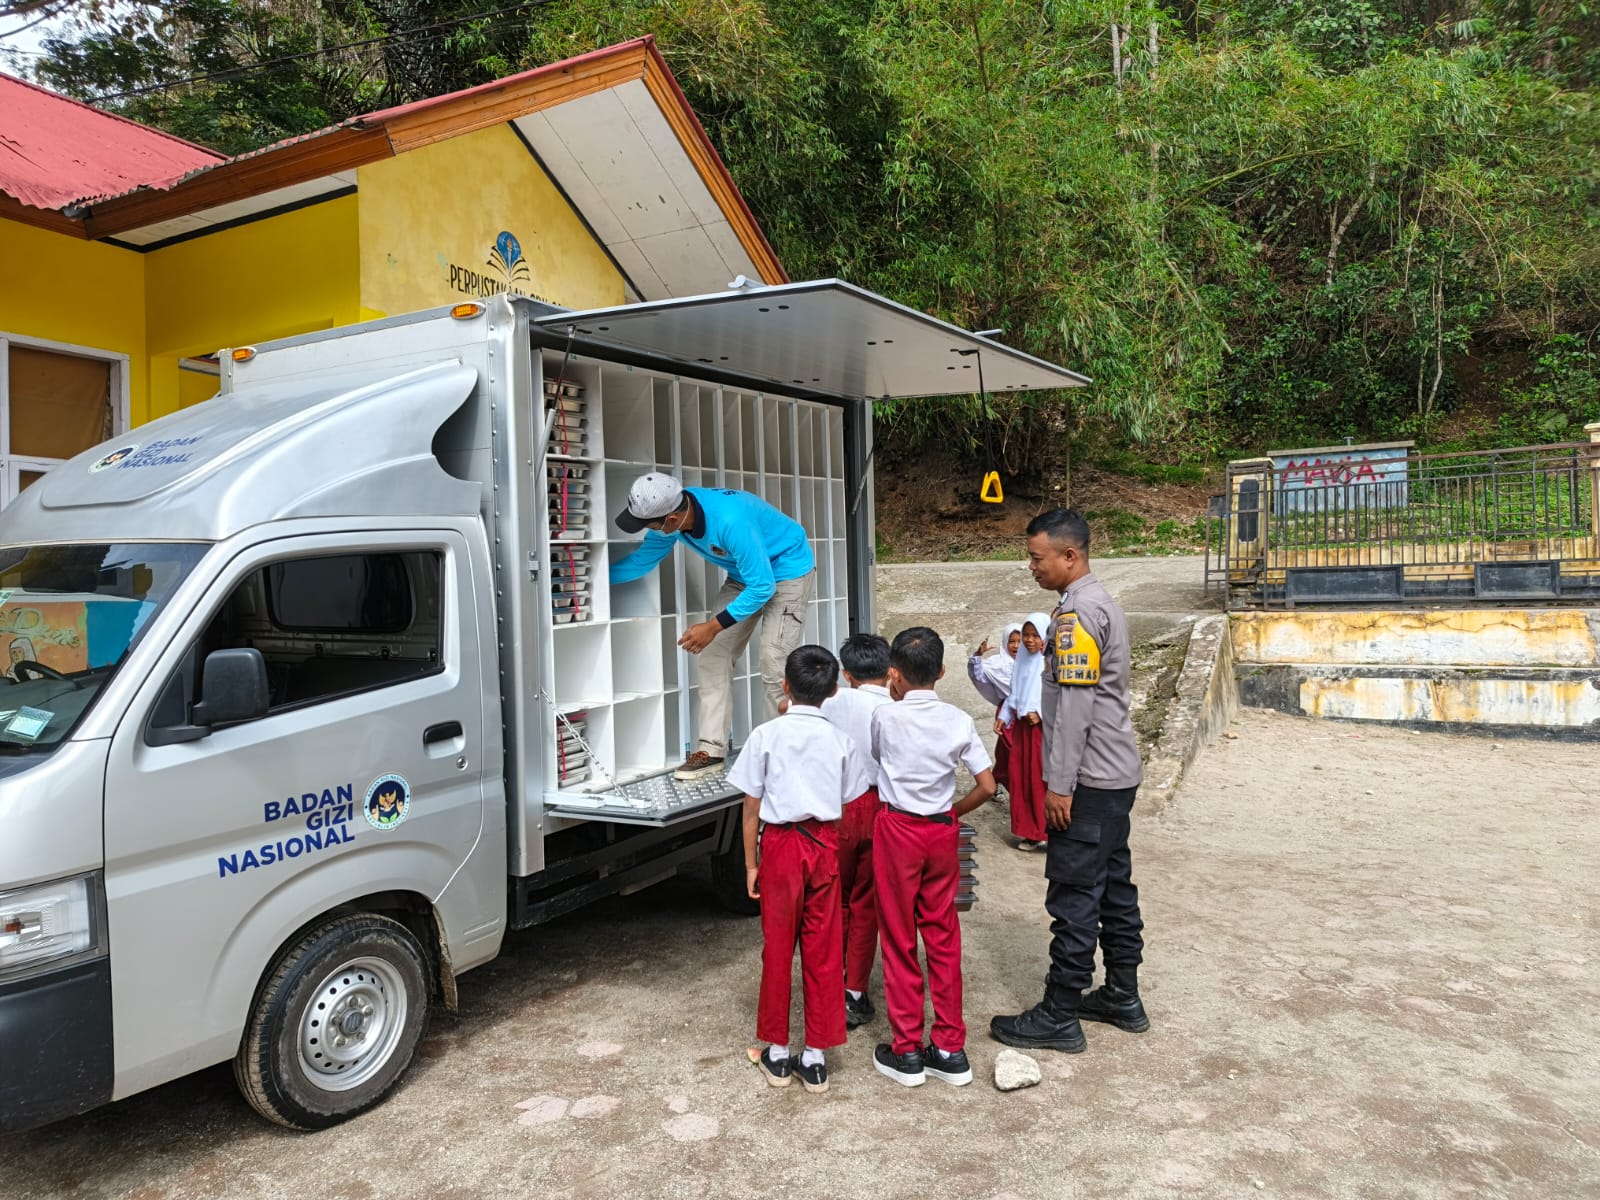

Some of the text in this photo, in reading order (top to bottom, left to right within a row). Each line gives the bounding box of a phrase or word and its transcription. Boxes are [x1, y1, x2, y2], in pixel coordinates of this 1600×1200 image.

[450, 263, 526, 298] PERPUSTAK
[264, 783, 353, 823] BADAN
[306, 803, 353, 831] GIZI
[218, 825, 356, 878] NASIONAL
